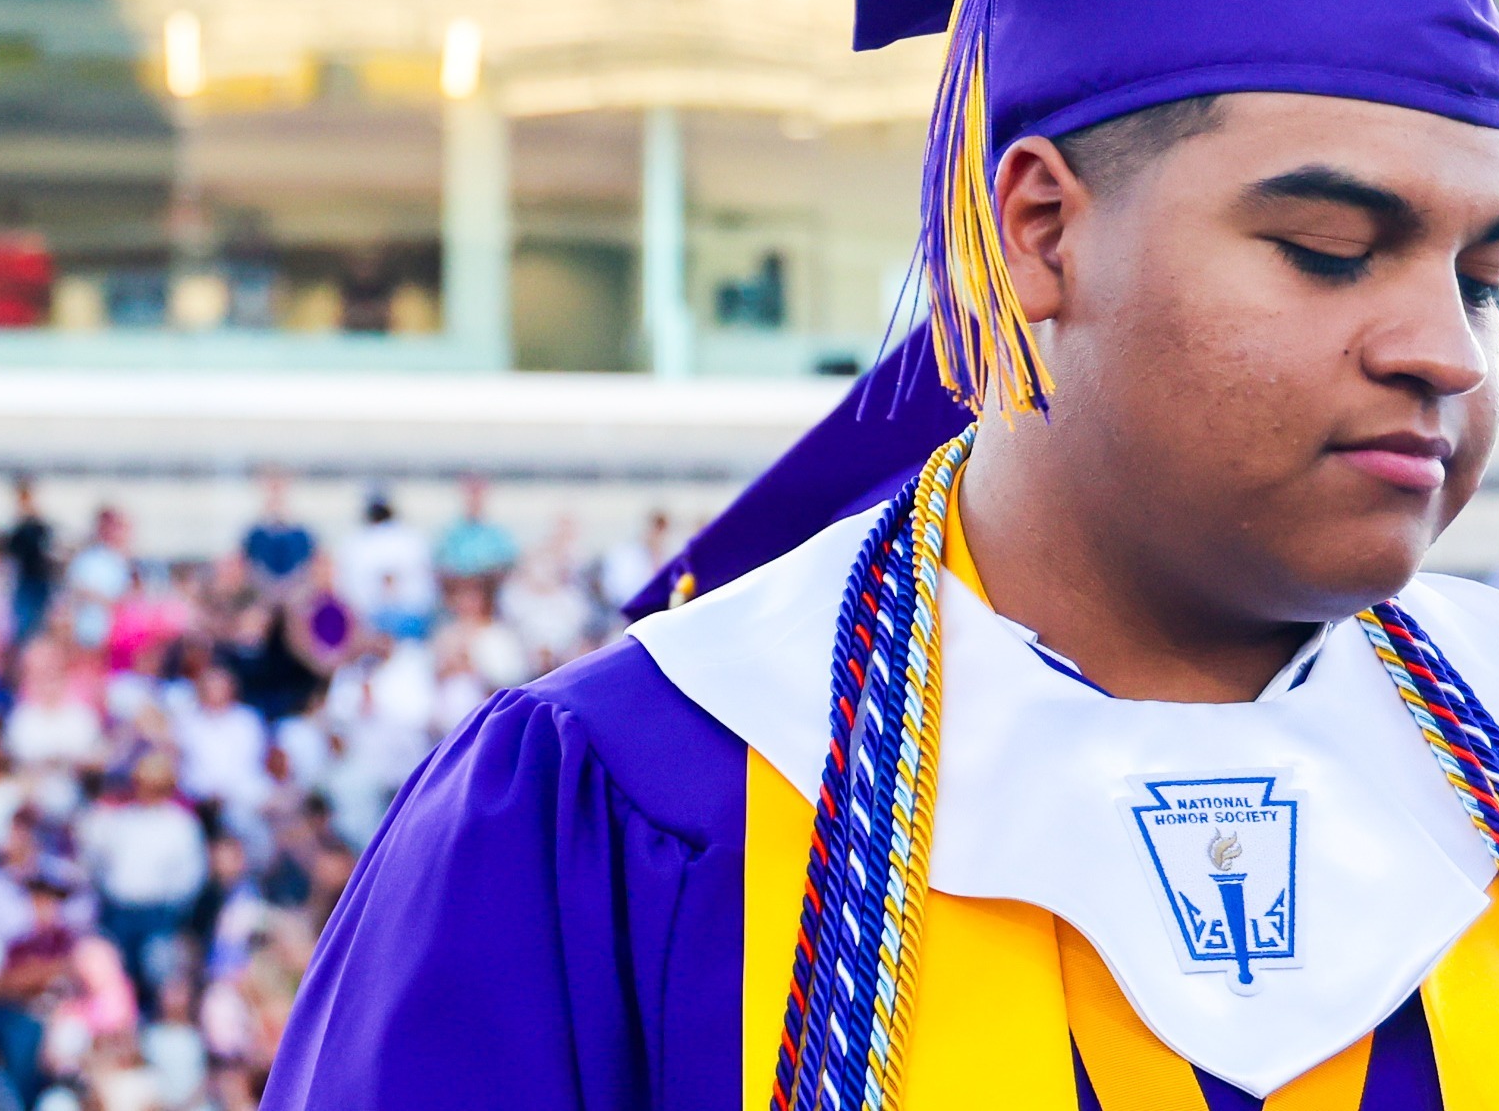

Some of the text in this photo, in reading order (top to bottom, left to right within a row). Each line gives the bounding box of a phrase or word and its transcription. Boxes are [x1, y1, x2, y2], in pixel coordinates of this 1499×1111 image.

[1177, 797, 1253, 810] NATIONAL
[1155, 810, 1278, 825] HONOR SOCIETY
